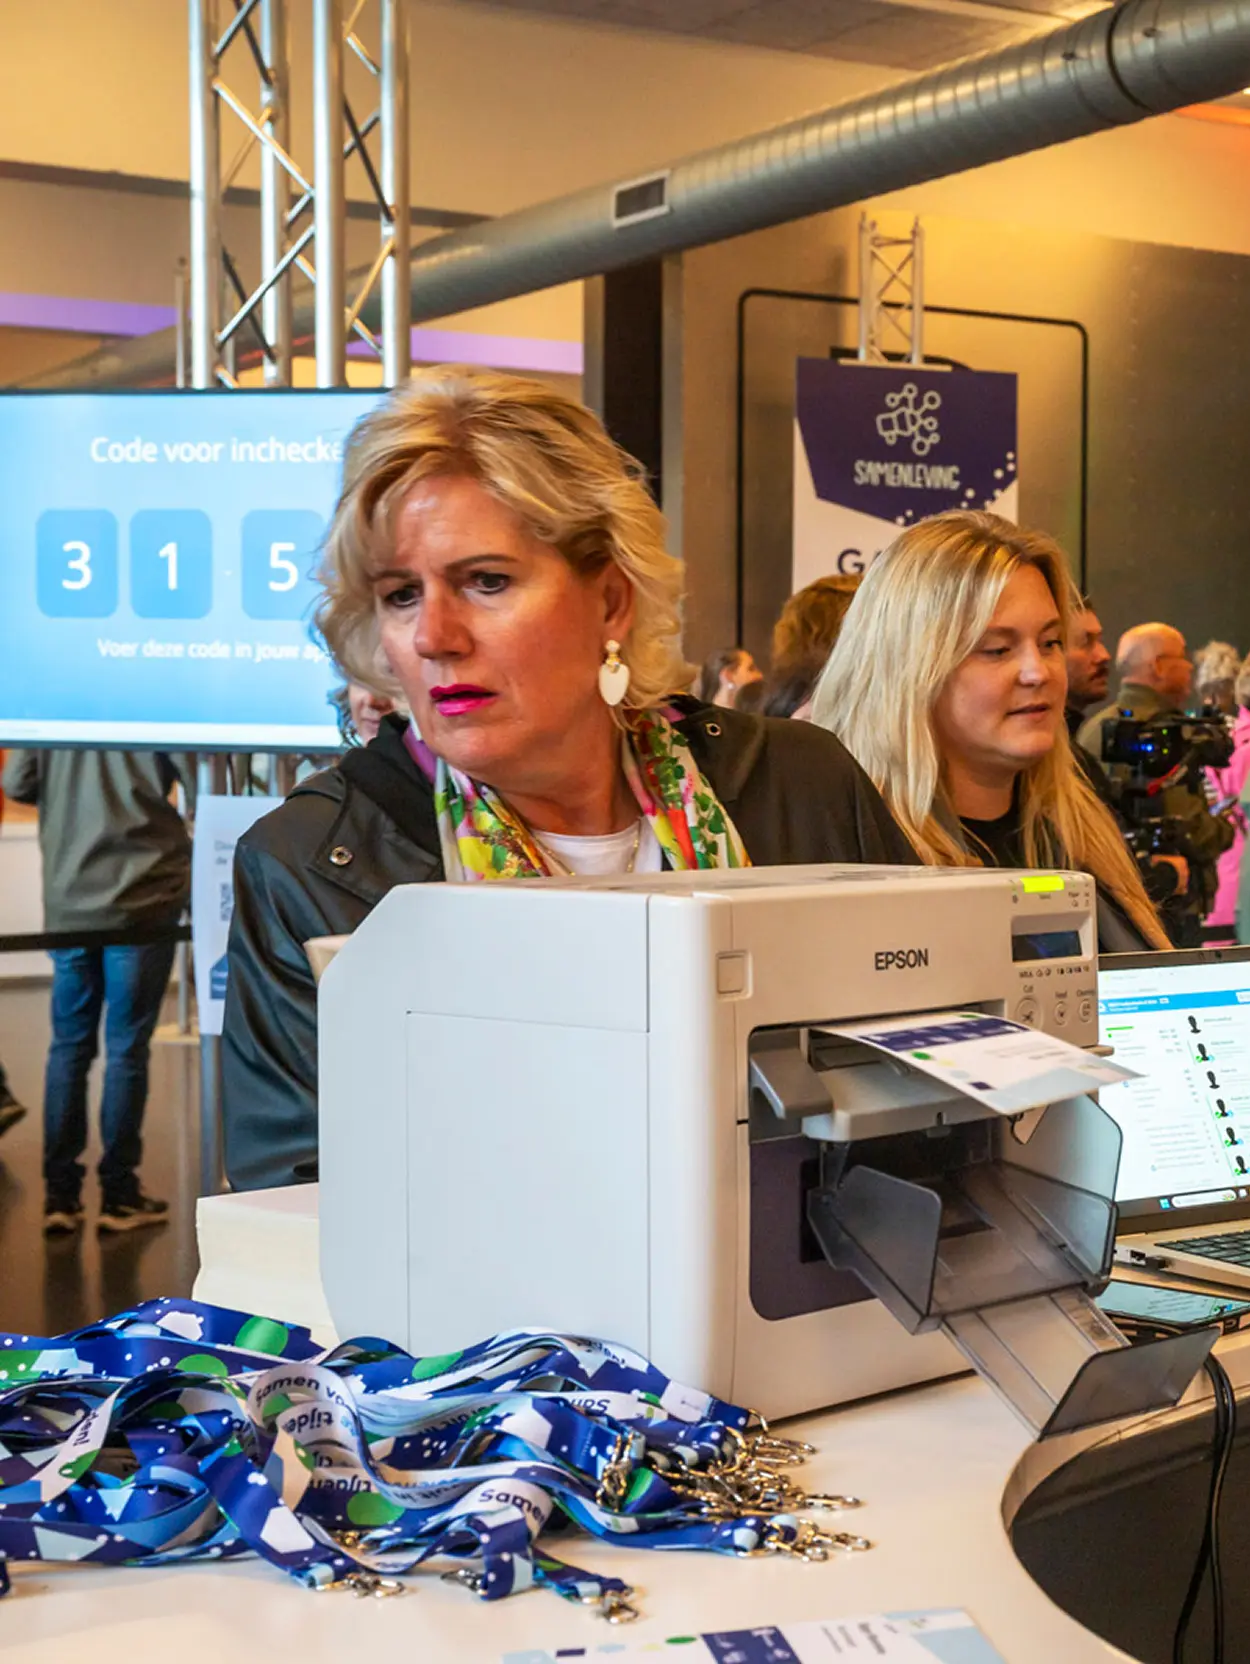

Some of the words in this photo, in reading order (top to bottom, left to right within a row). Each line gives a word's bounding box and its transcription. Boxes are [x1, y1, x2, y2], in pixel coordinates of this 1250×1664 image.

[90, 437, 158, 463] Code
[163, 441, 224, 463] voor
[853, 459, 961, 491] SAMENLEVING
[61, 540, 93, 590] 3
[158, 541, 178, 591] 1
[267, 541, 300, 592] 5
[836, 547, 883, 577] G
[97, 638, 139, 657] Voer
[142, 640, 183, 658] deze
[187, 640, 231, 658] code
[235, 640, 252, 658] in
[255, 641, 300, 663] jouw
[874, 947, 929, 971] EPSON
[326, 1386, 348, 1407] vo
[283, 1407, 333, 1433] tijde
